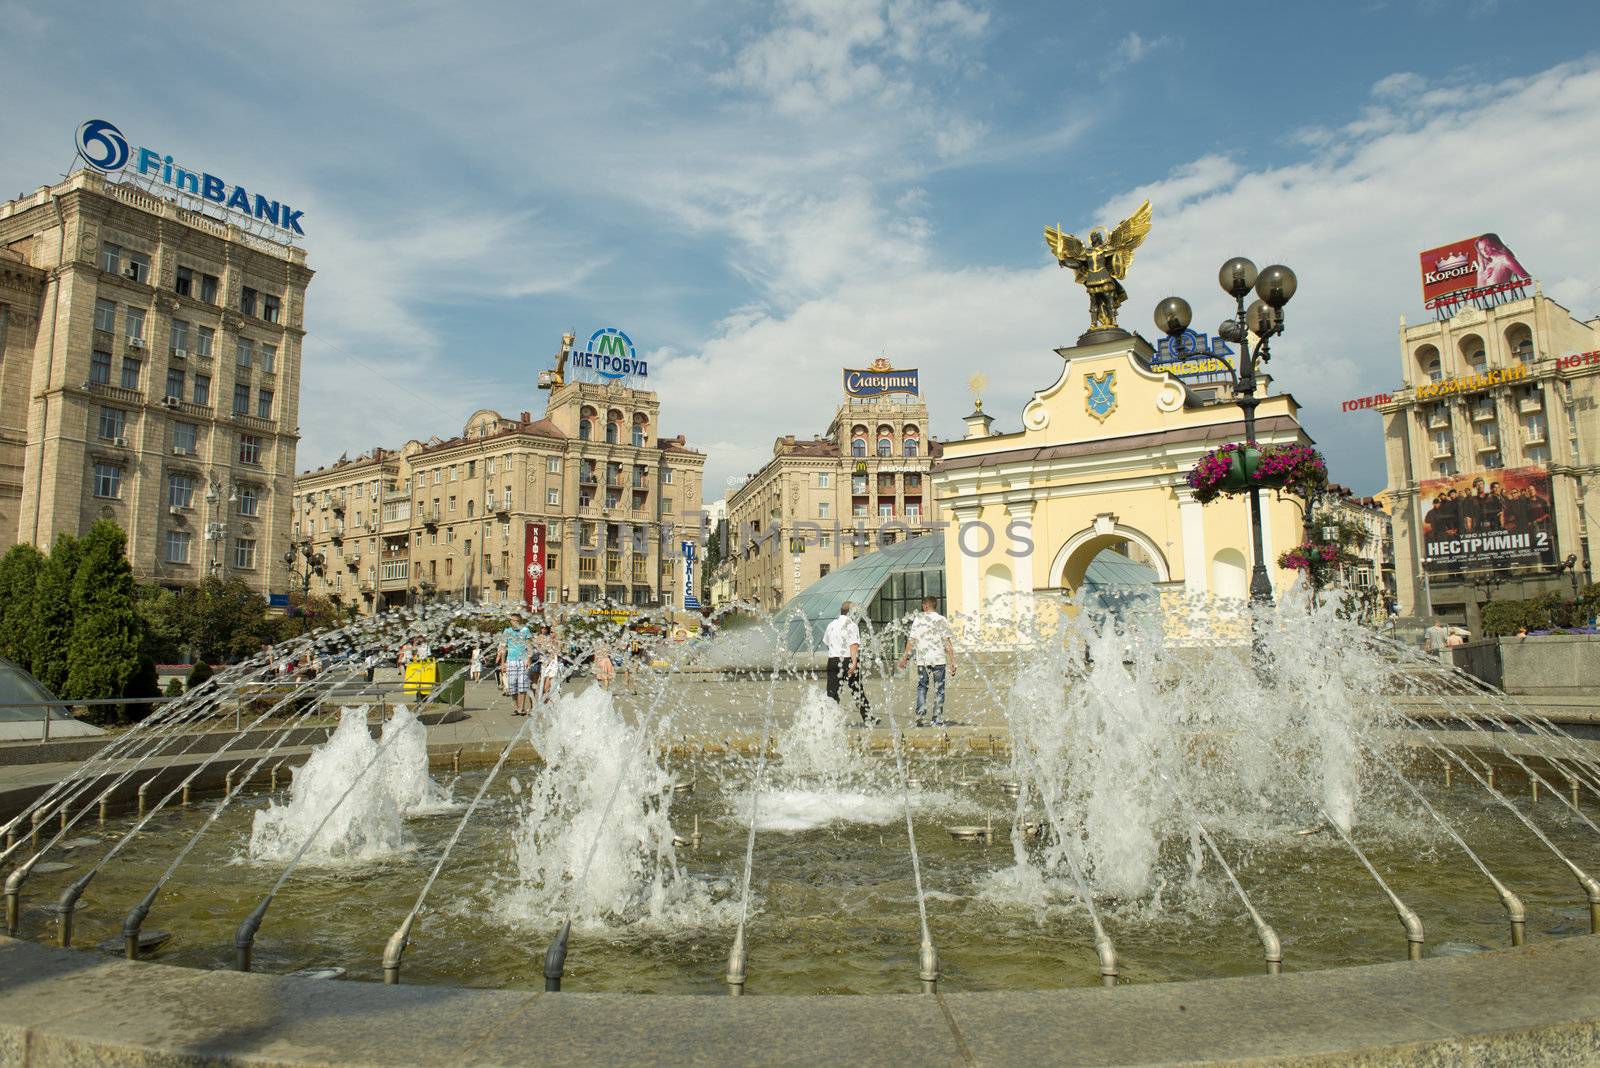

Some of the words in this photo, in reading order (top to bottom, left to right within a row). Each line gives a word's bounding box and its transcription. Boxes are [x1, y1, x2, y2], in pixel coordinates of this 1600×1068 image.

[137, 146, 305, 236] FinBANK
[573, 351, 648, 376] МЕТРОБУД
[847, 372, 917, 392] Славутич
[1415, 363, 1527, 400] КОЗАЦЬКИЙ
[1342, 394, 1392, 412] ГОТЕЛЬ
[1427, 533, 1530, 556] НЕСТРИМНІ
[1536, 532, 1549, 546] 2
